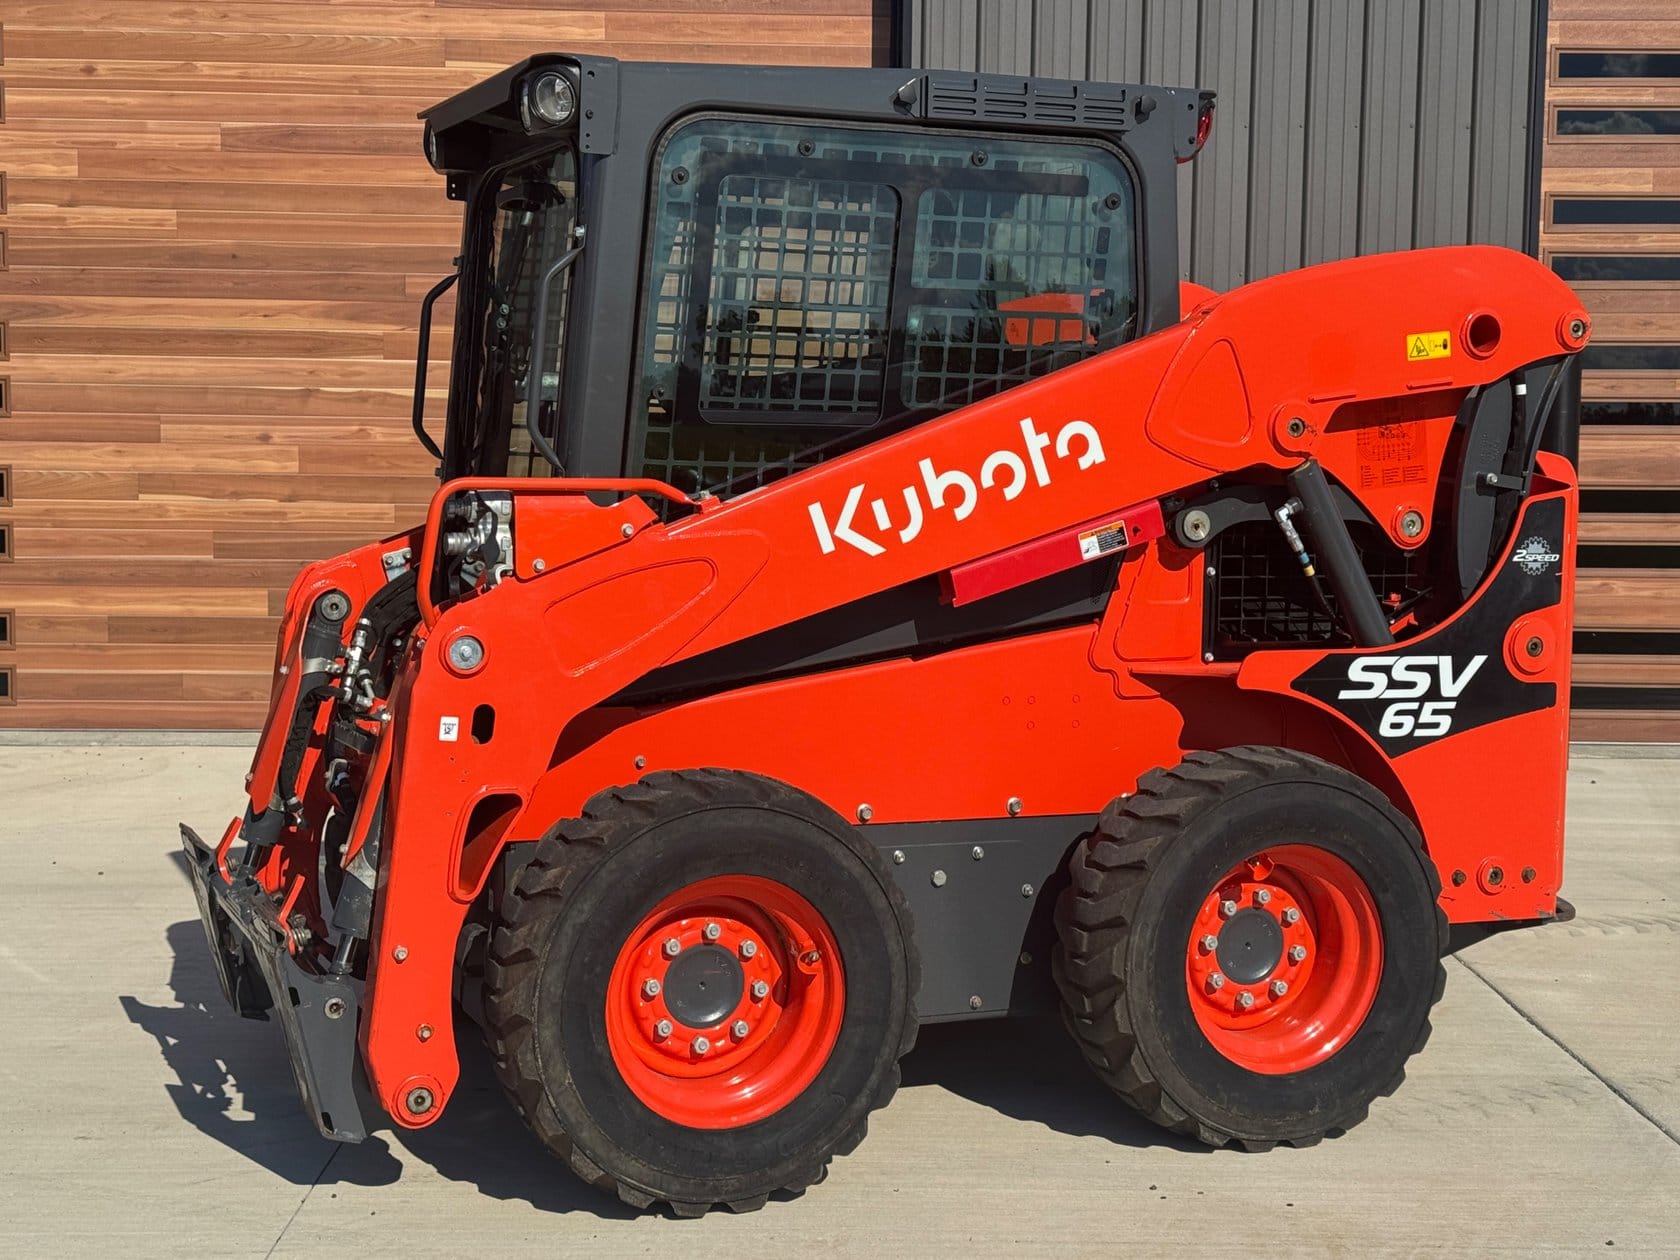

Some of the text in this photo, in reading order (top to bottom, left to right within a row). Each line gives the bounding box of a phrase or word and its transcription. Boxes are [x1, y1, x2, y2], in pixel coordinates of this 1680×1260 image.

[807, 416, 1106, 557] Kubota
[1338, 655, 1488, 699] SSV
[1379, 701, 1457, 738] 65
